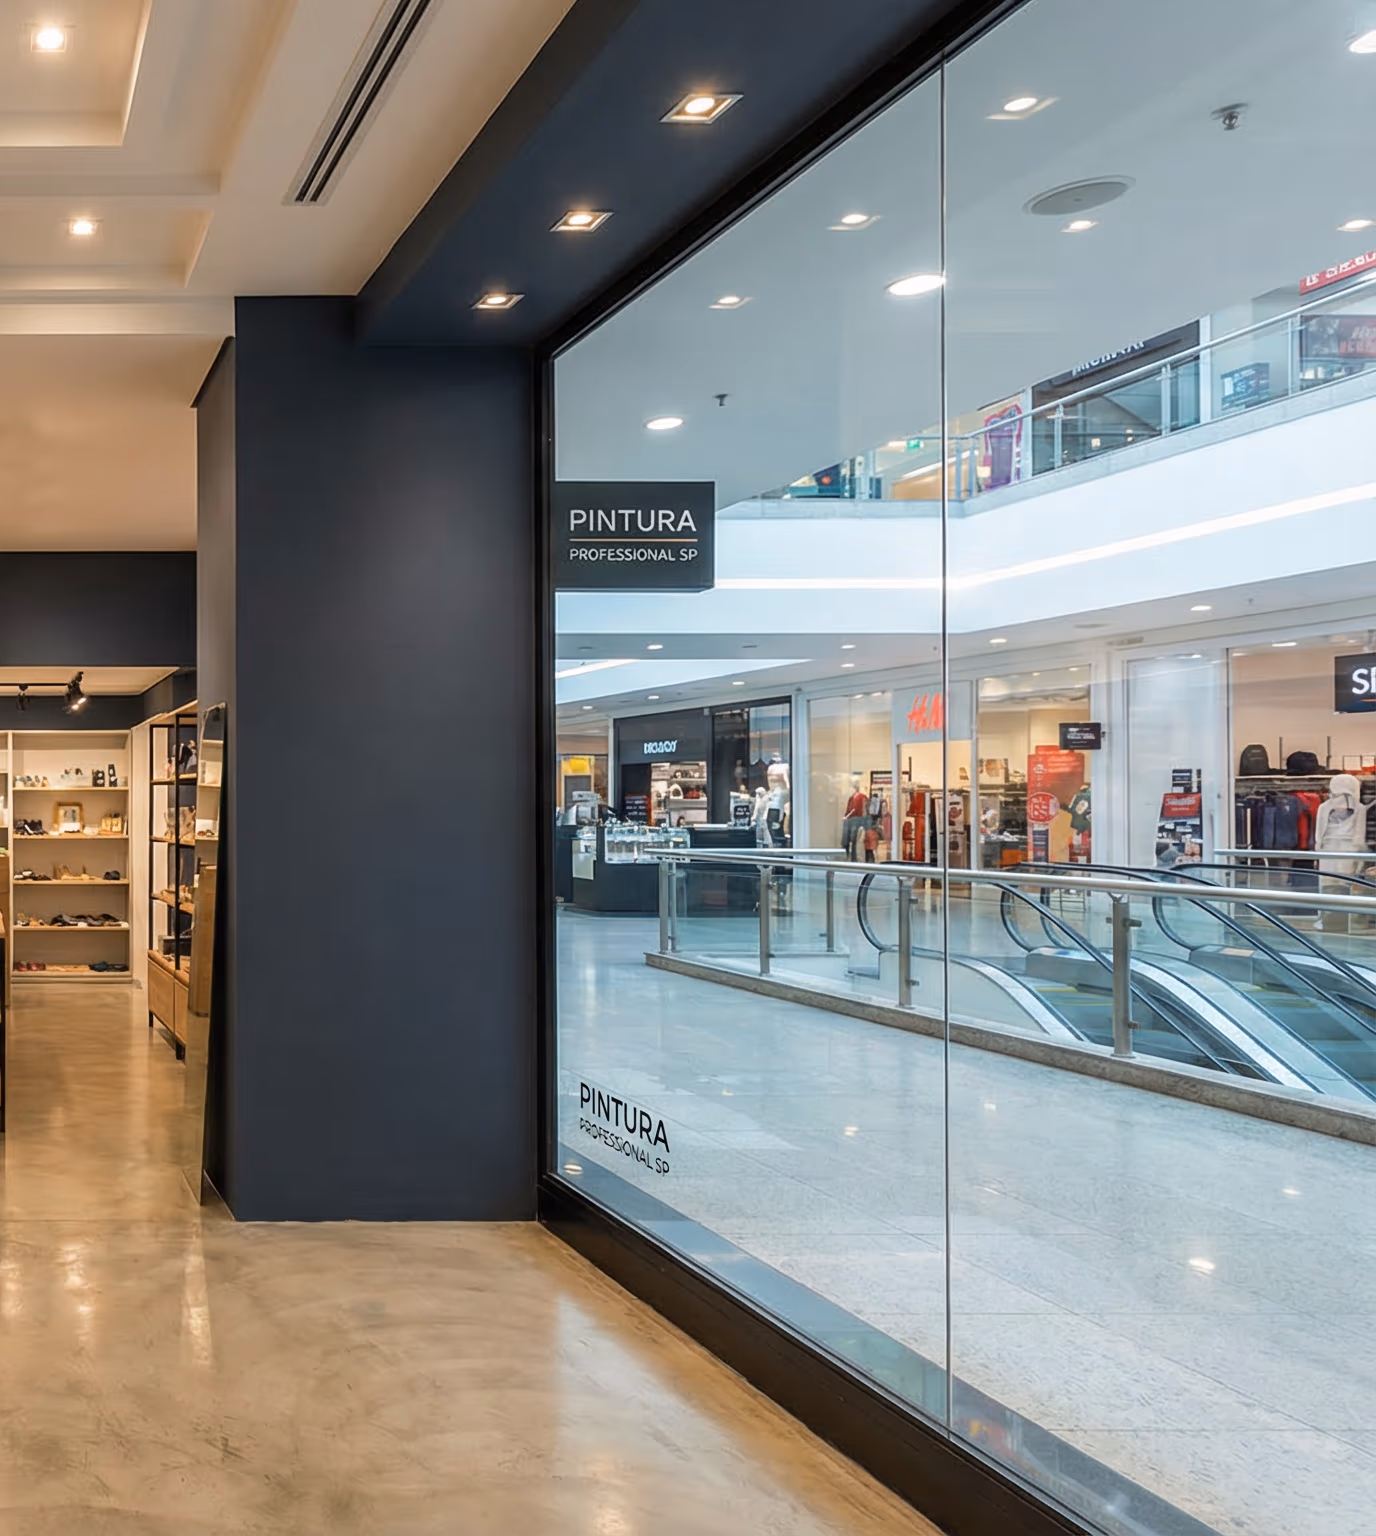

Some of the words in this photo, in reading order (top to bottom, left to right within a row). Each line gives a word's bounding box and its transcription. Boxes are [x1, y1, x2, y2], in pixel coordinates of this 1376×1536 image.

[569, 509, 697, 532] PINTURA
[569, 548, 676, 562] PROFESSIONAL
[679, 548, 698, 562] SP
[580, 1082, 670, 1154] PINTURA
[579, 1117, 654, 1170] PROFESSIONAL
[655, 1157, 670, 1177] SP
